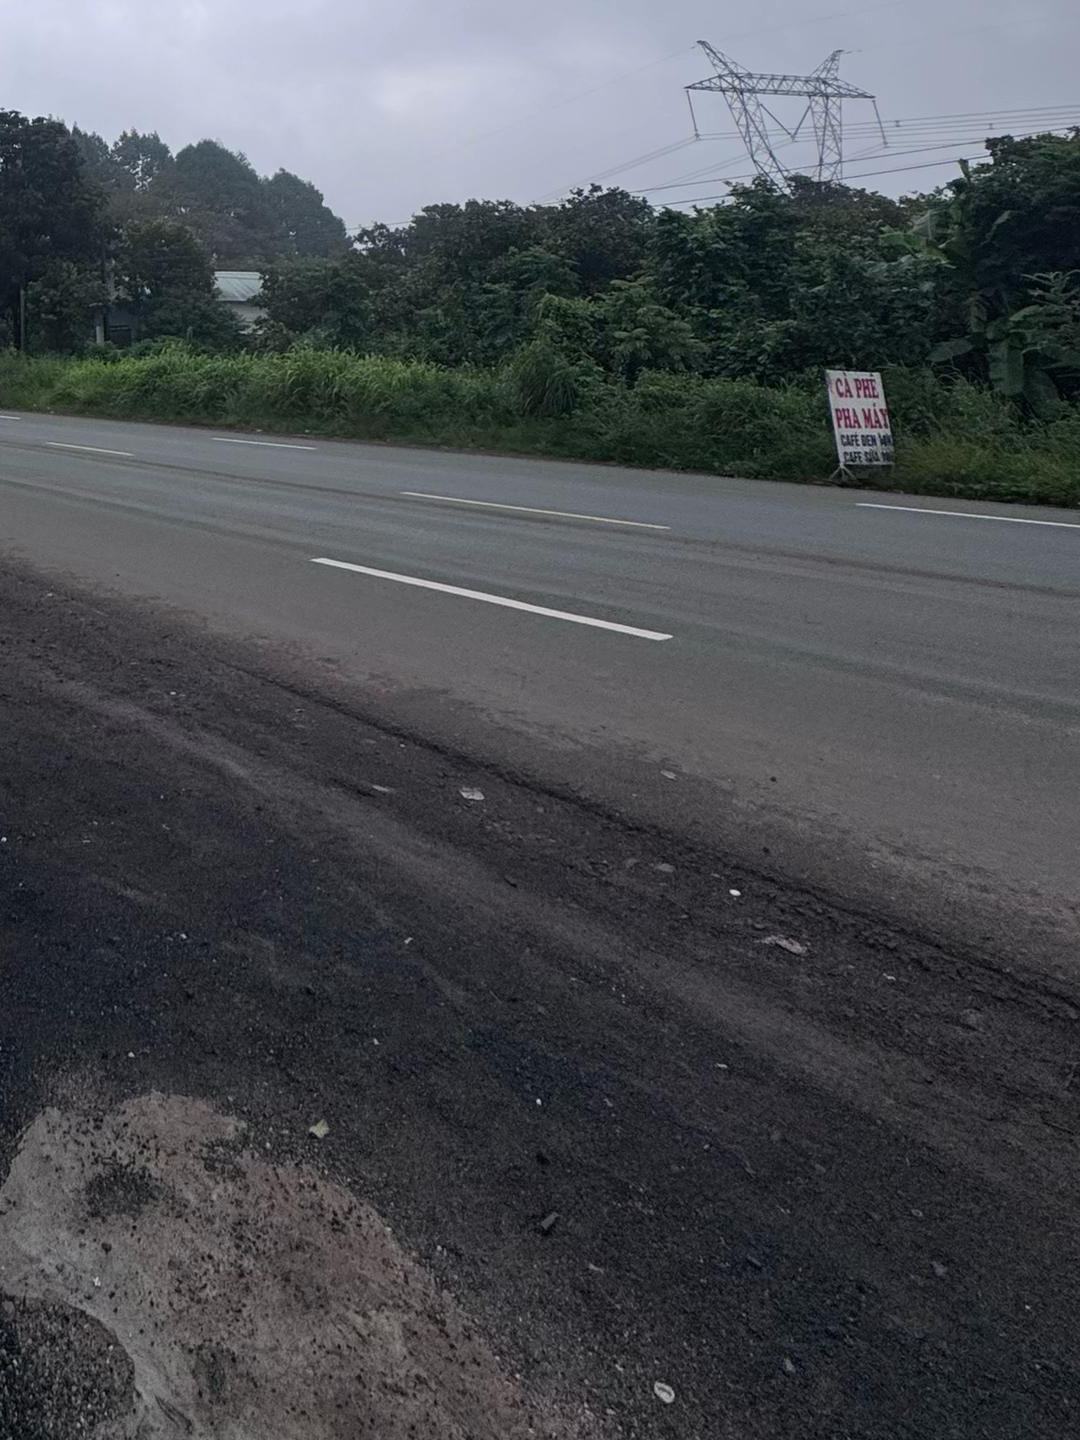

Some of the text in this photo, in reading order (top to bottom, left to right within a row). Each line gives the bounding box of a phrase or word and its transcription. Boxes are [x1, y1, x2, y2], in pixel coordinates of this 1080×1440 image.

[835, 372, 879, 399] CÀ PHÊ
[835, 403, 889, 429] PHA MÁY
